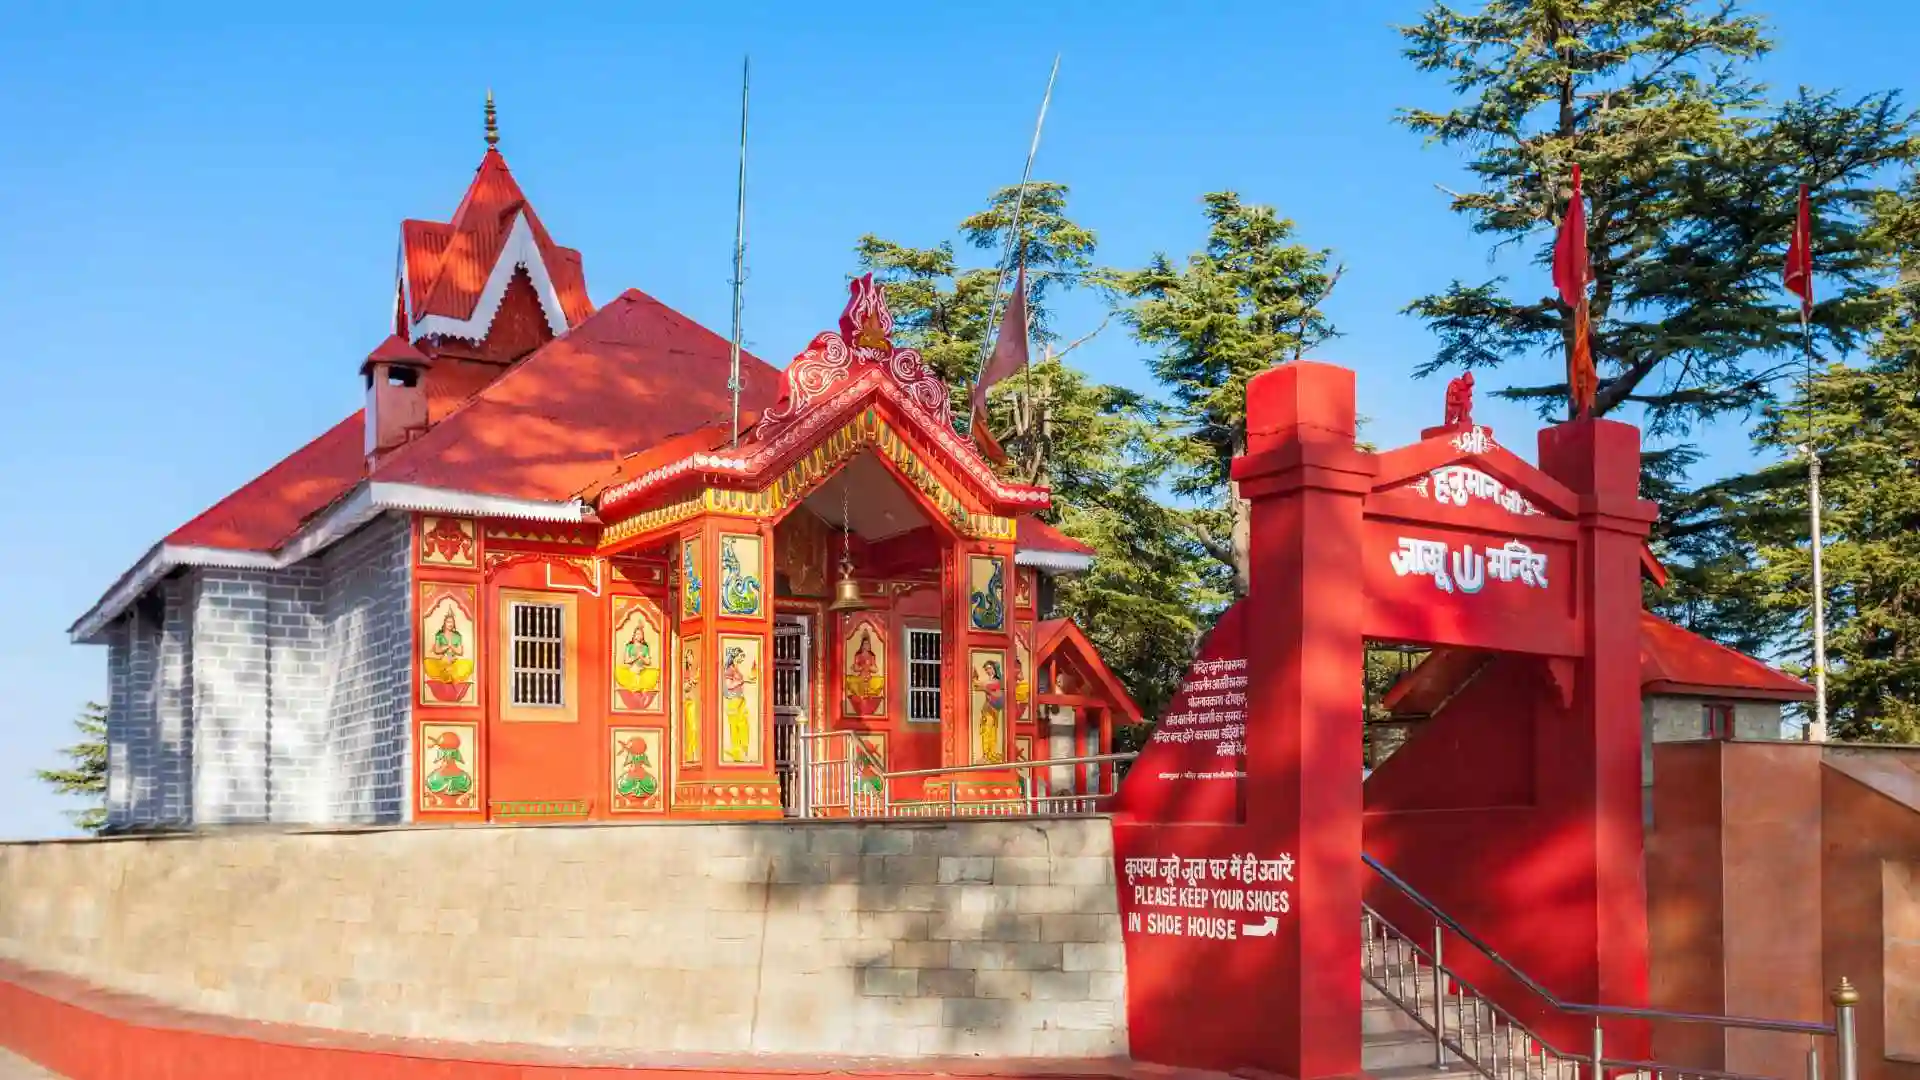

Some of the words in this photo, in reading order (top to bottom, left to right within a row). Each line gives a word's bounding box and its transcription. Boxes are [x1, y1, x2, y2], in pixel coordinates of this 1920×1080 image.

[1390, 537, 1454, 593] जाखू
[1125, 857, 1157, 886] कृपया
[1159, 853, 1181, 887] जूते
[1181, 858, 1207, 887] जूता
[1209, 858, 1229, 880] घर
[1230, 853, 1242, 881] में
[1243, 851, 1259, 884] ही
[1258, 852, 1296, 883] उतारें
[1135, 885, 1177, 907] PLEASE
[1179, 886, 1209, 908] KEEP
[1211, 888, 1244, 911] YOUR
[1246, 889, 1290, 913] SHOES
[1128, 911, 1141, 932] IN
[1147, 912, 1182, 936] SHOE
[1187, 915, 1237, 940] HOUSE
